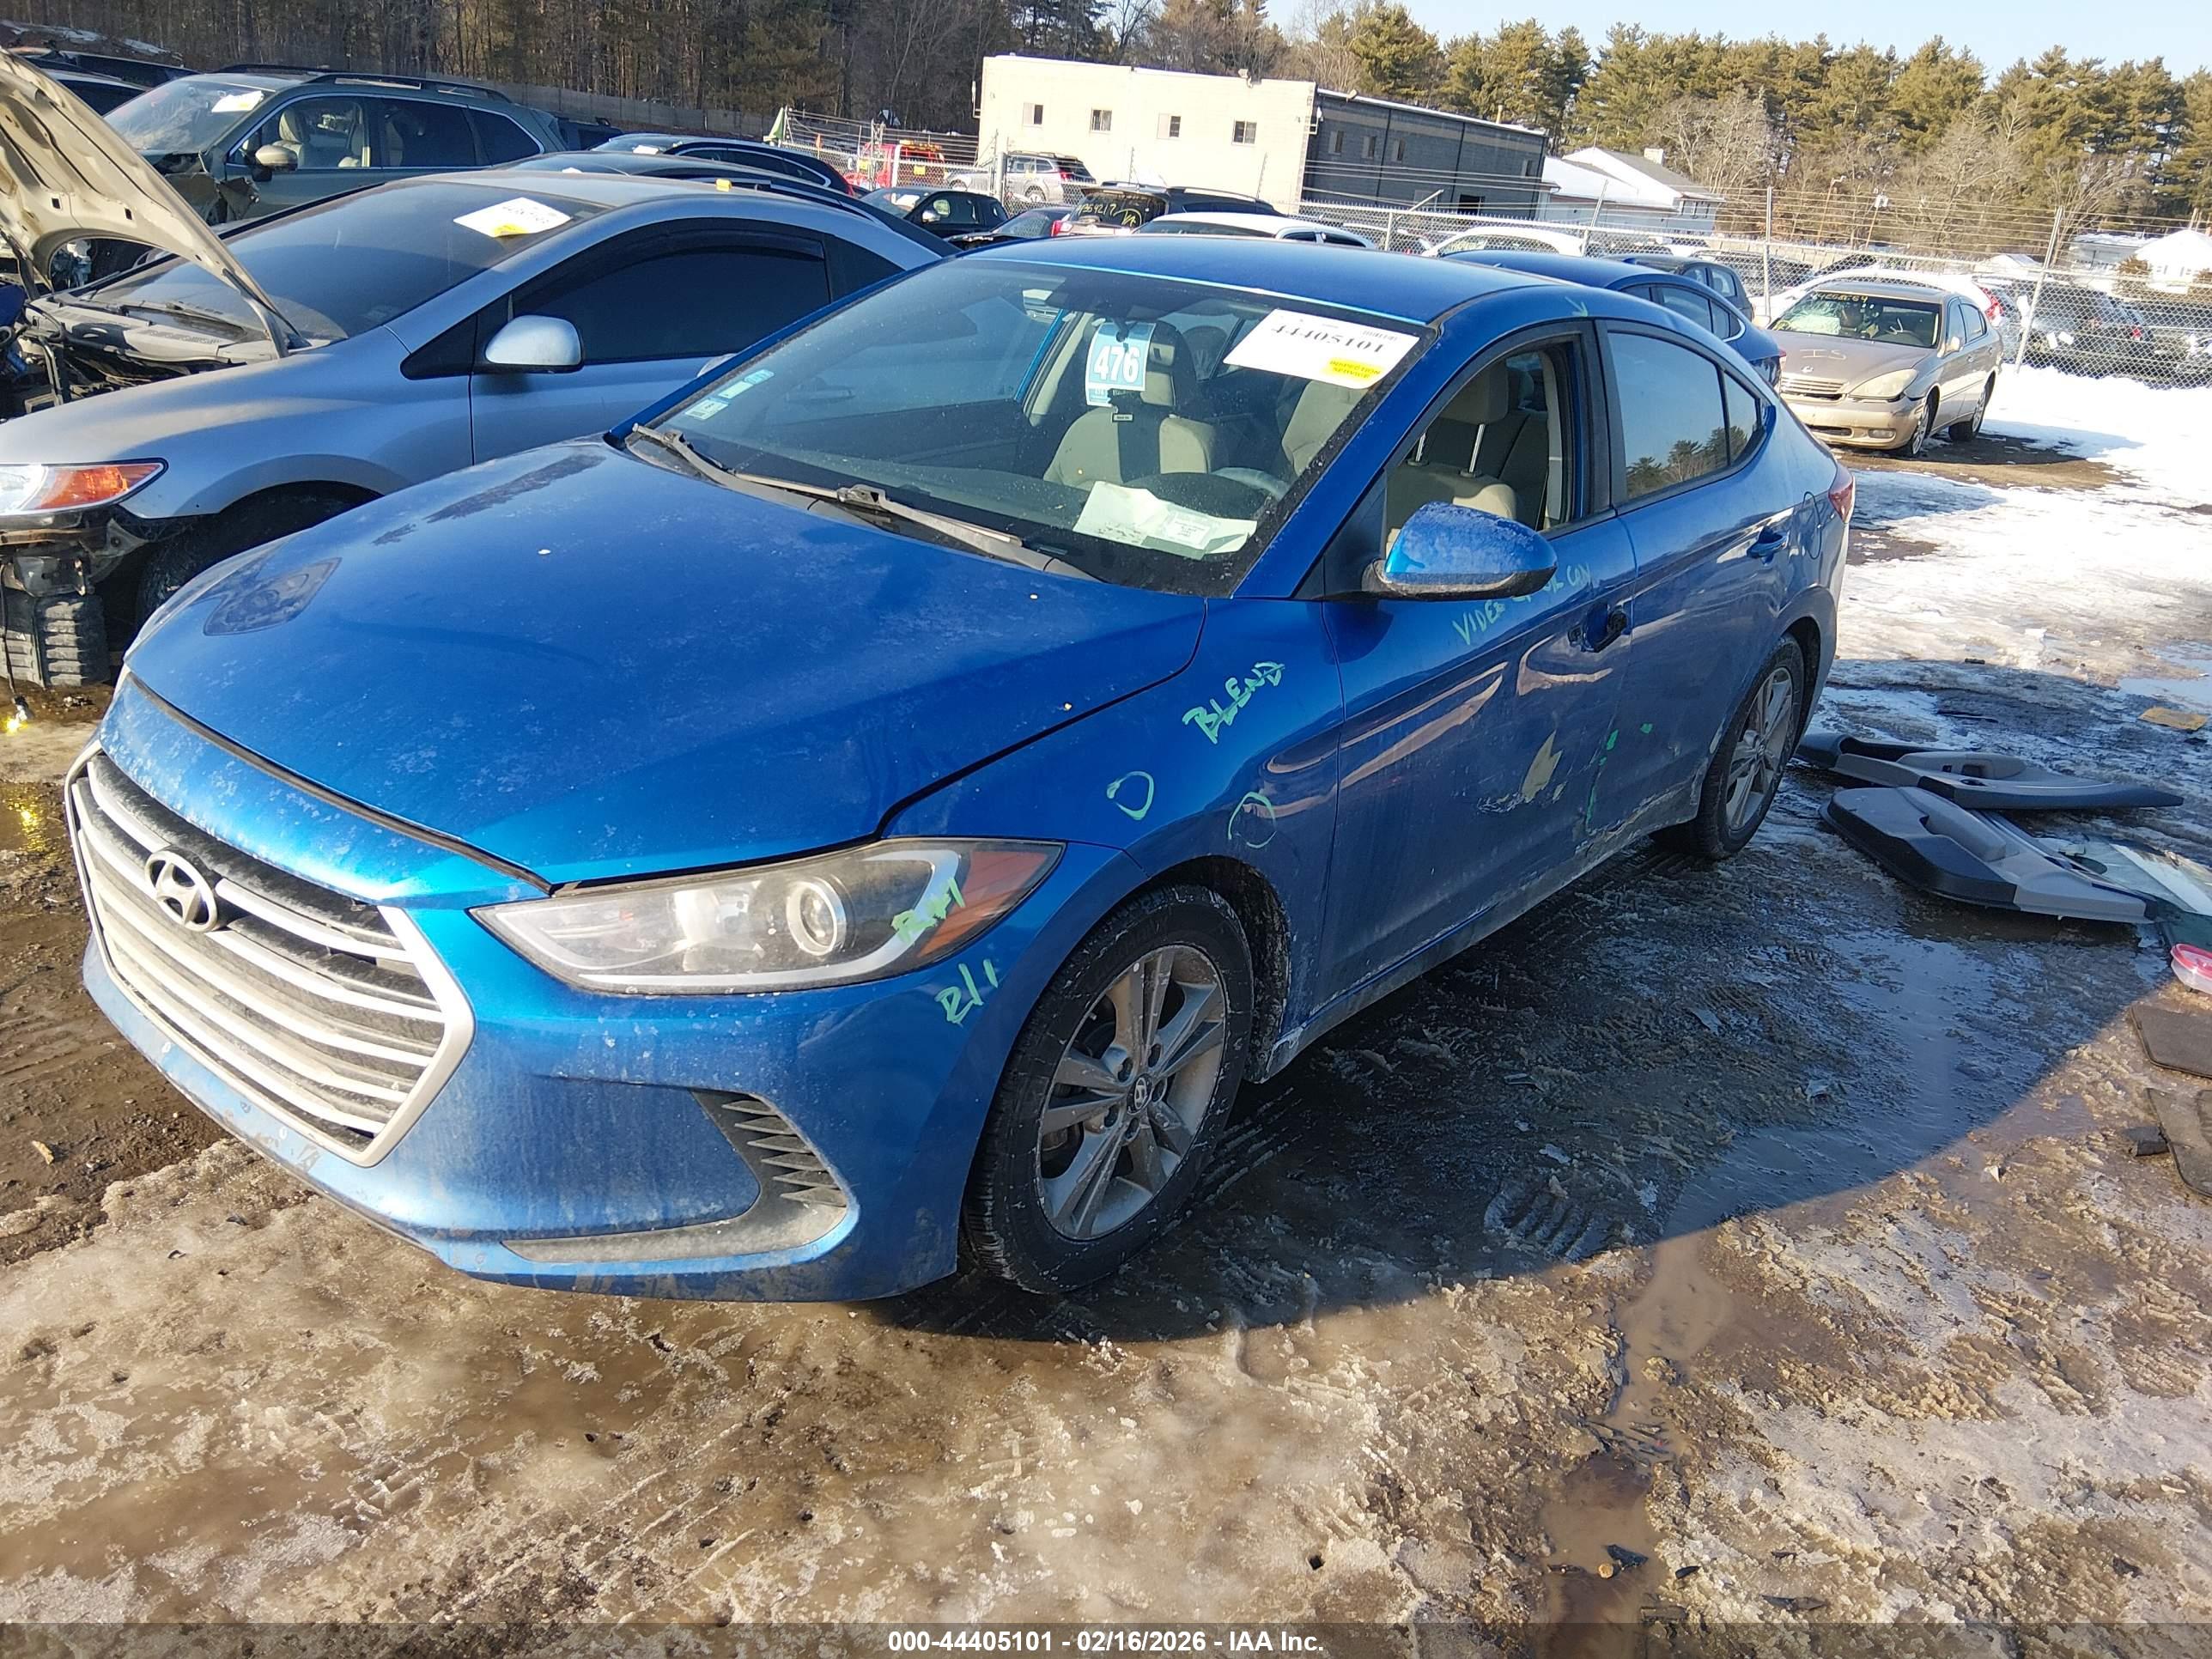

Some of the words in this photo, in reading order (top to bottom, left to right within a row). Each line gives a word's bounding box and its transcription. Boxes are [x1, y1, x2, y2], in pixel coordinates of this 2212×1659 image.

[1271, 325, 1383, 353] 44405101
[1093, 344, 1141, 384] 476
[1182, 661, 1285, 744] BLEND
